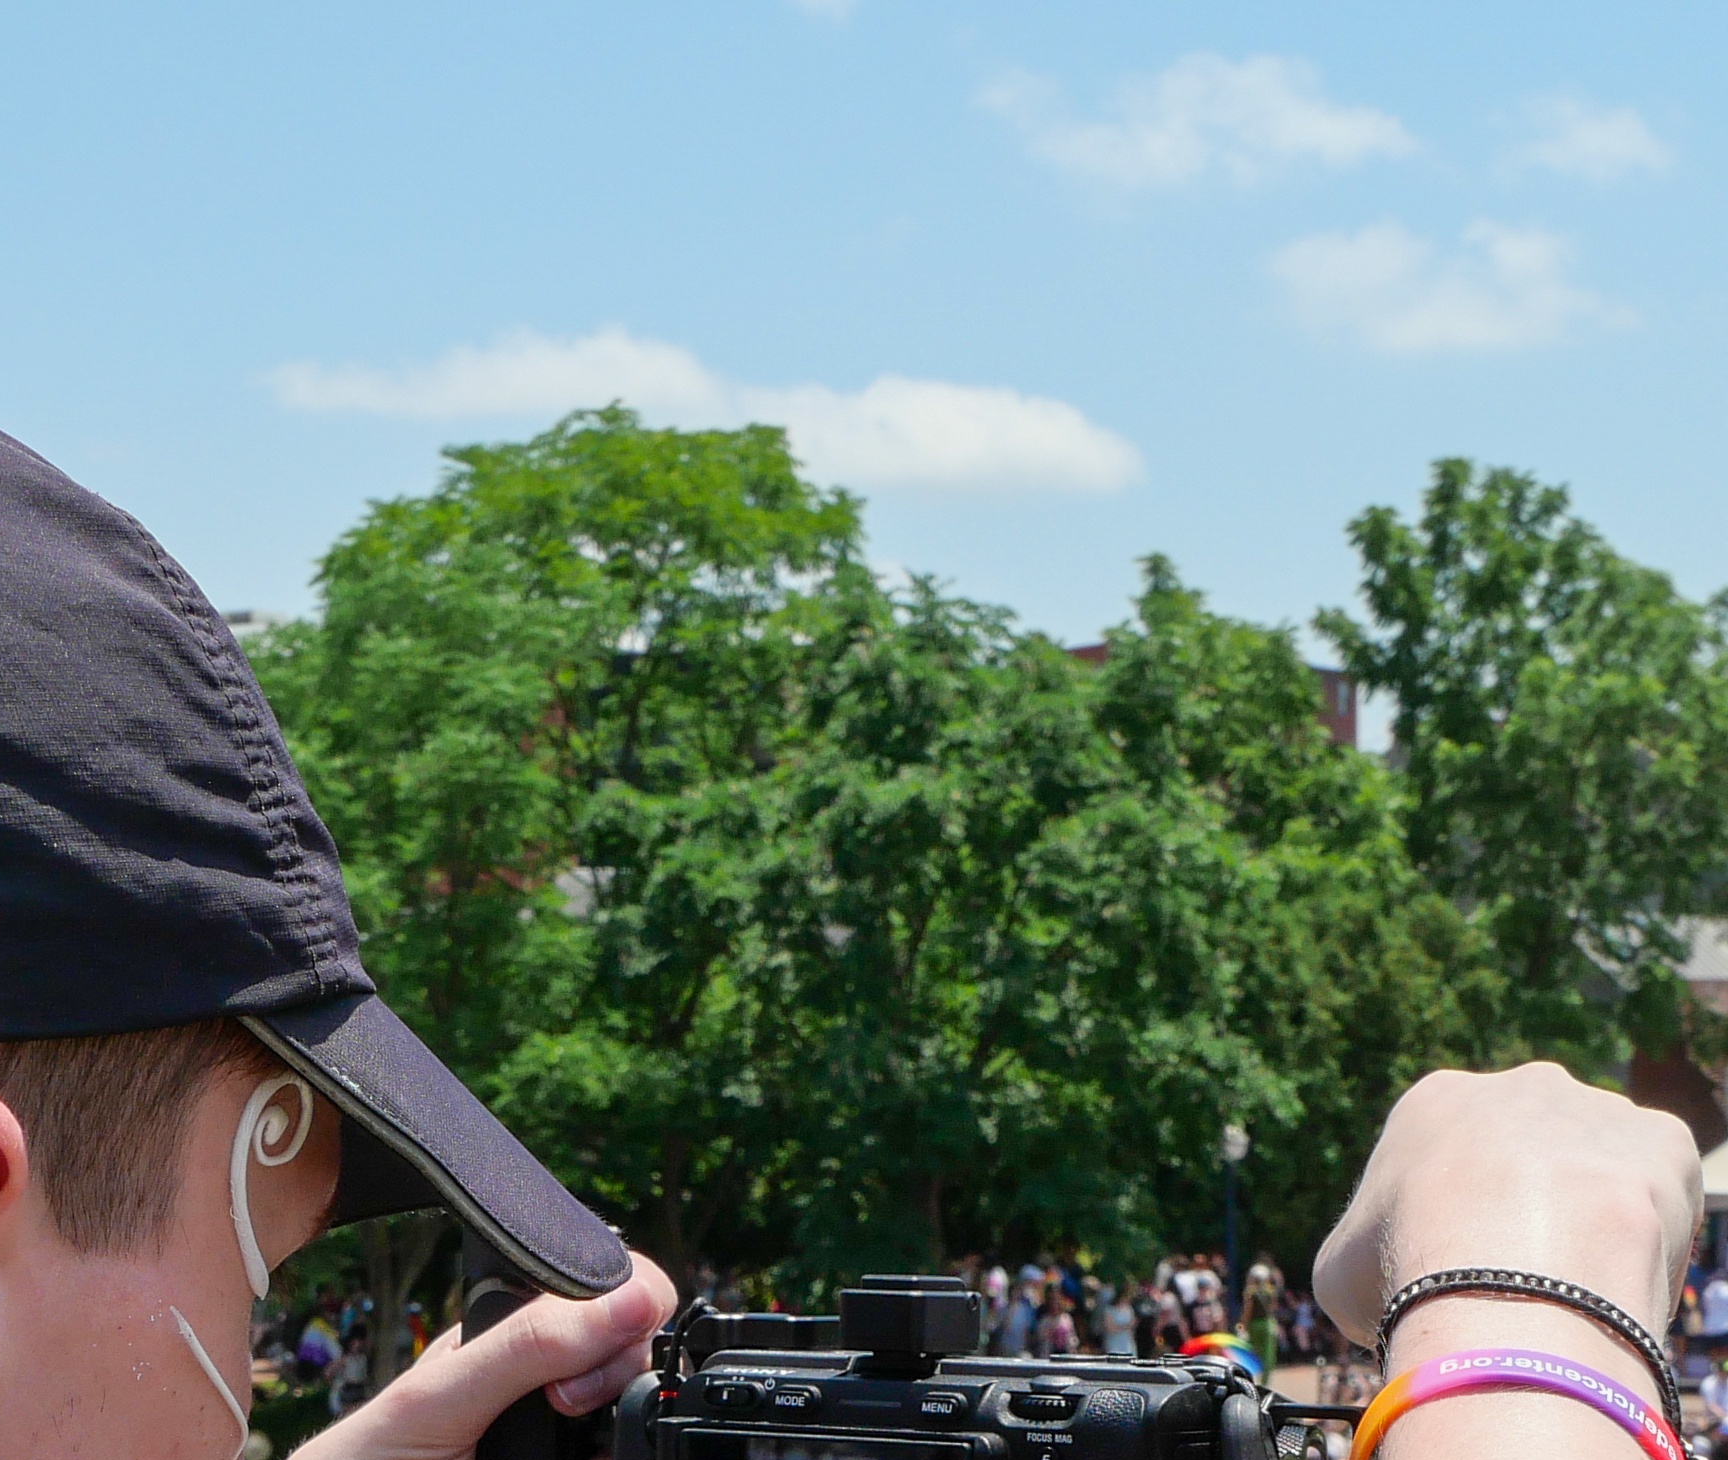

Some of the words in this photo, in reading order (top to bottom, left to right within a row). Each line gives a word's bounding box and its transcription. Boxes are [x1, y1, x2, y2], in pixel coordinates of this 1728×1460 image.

[774, 1394, 806, 1408] MODE
[921, 1401, 953, 1415] MENU
[1026, 1432, 1053, 1443] FOCUS
[1054, 1433, 1073, 1445] MAG
